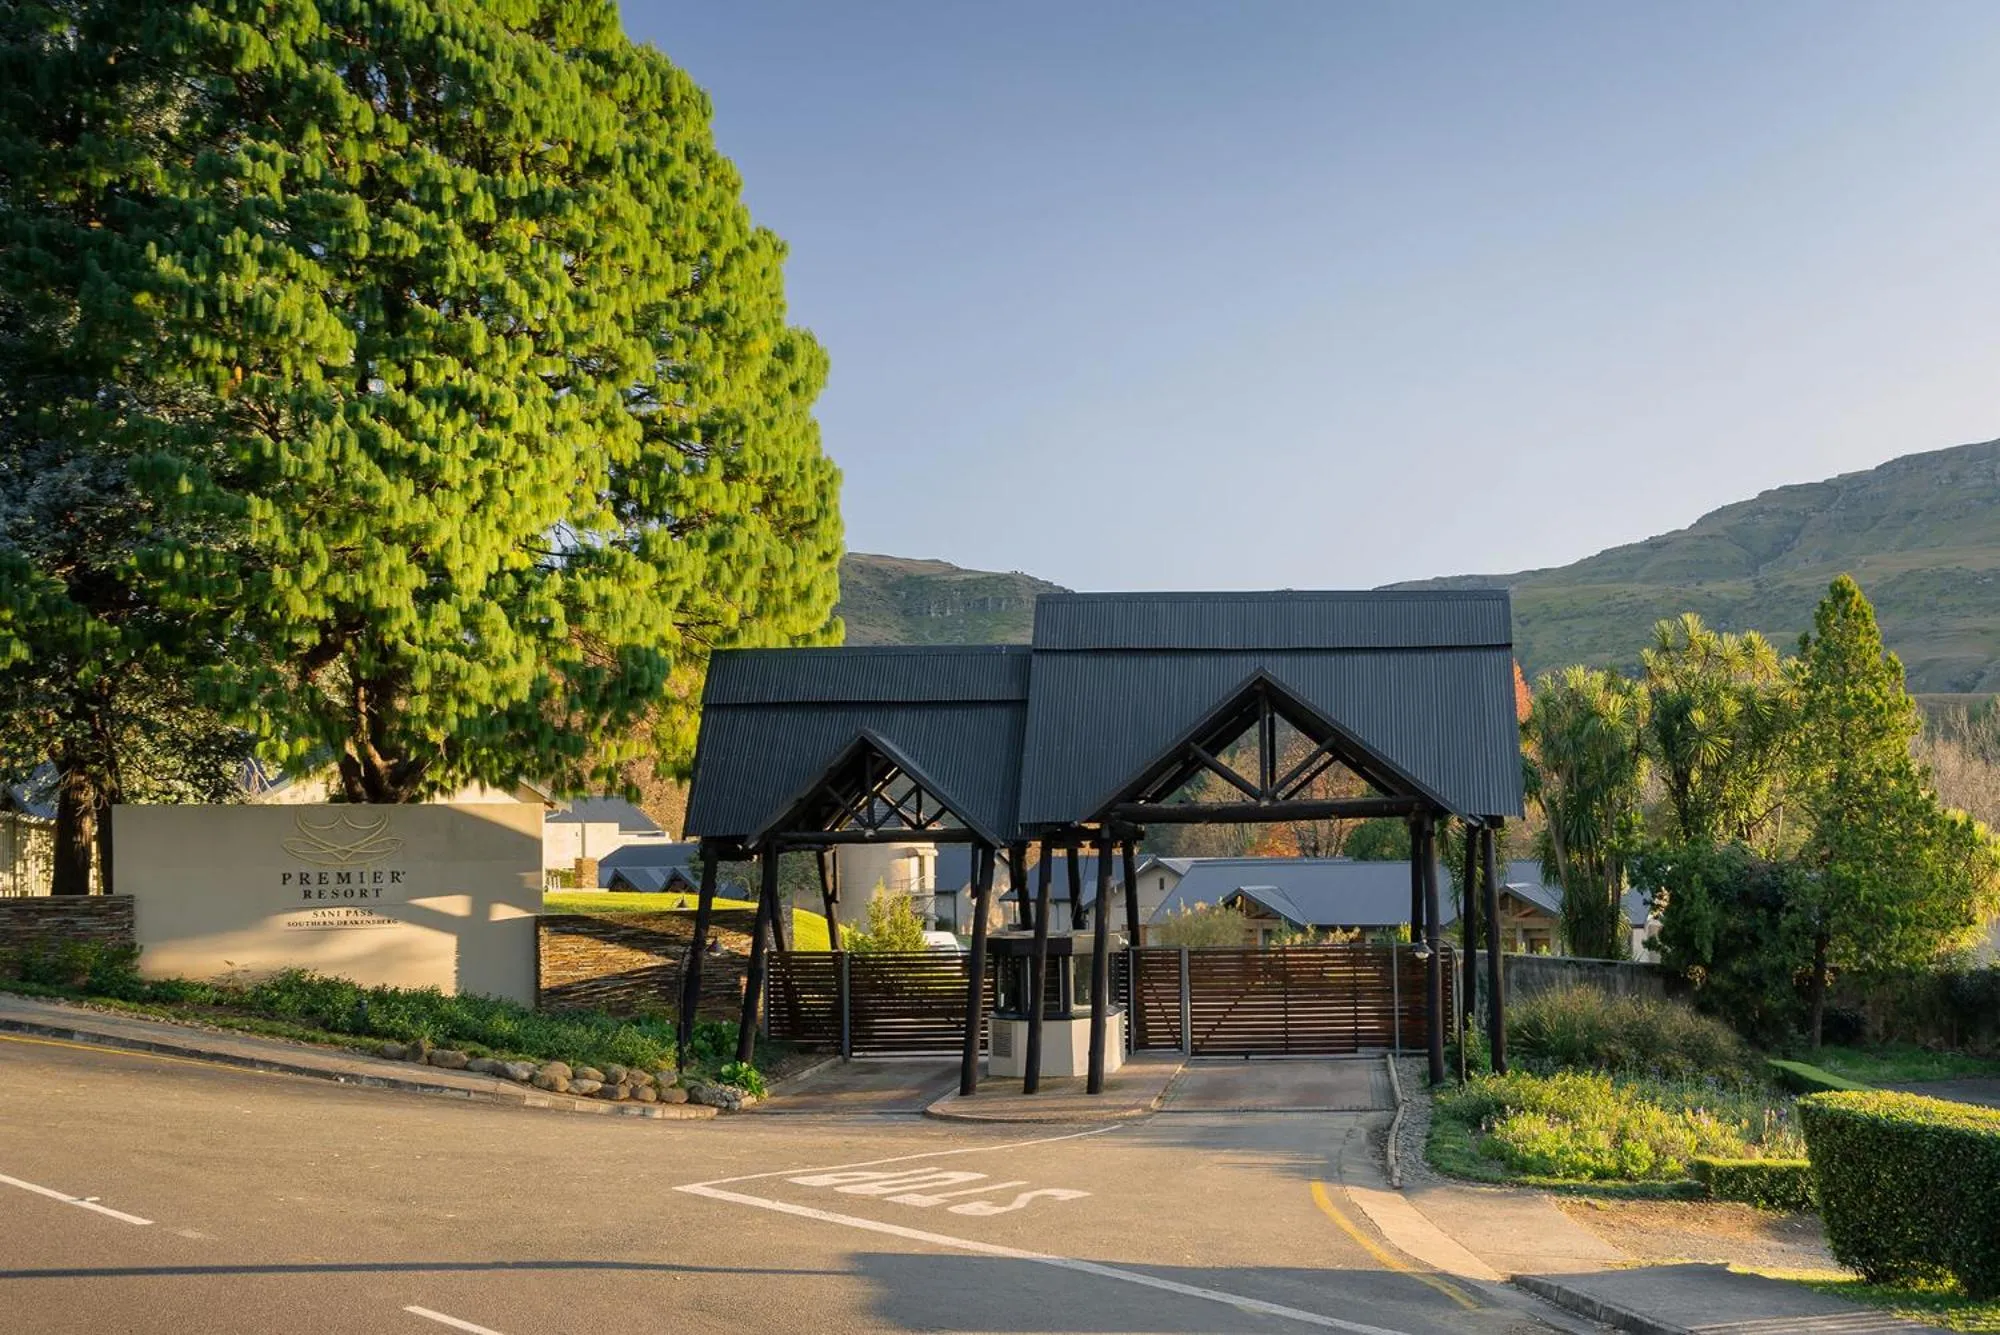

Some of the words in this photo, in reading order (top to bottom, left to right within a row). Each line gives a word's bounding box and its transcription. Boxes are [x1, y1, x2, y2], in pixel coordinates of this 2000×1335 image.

[281, 870, 404, 885] PREMIER
[302, 887, 383, 900] RESORT
[312, 909, 340, 918] SANI
[345, 908, 374, 917] PASS
[287, 920, 335, 928] SOUTHERN
[336, 918, 398, 927] DRAKENSBERG
[786, 1166, 1092, 1216] STOP
